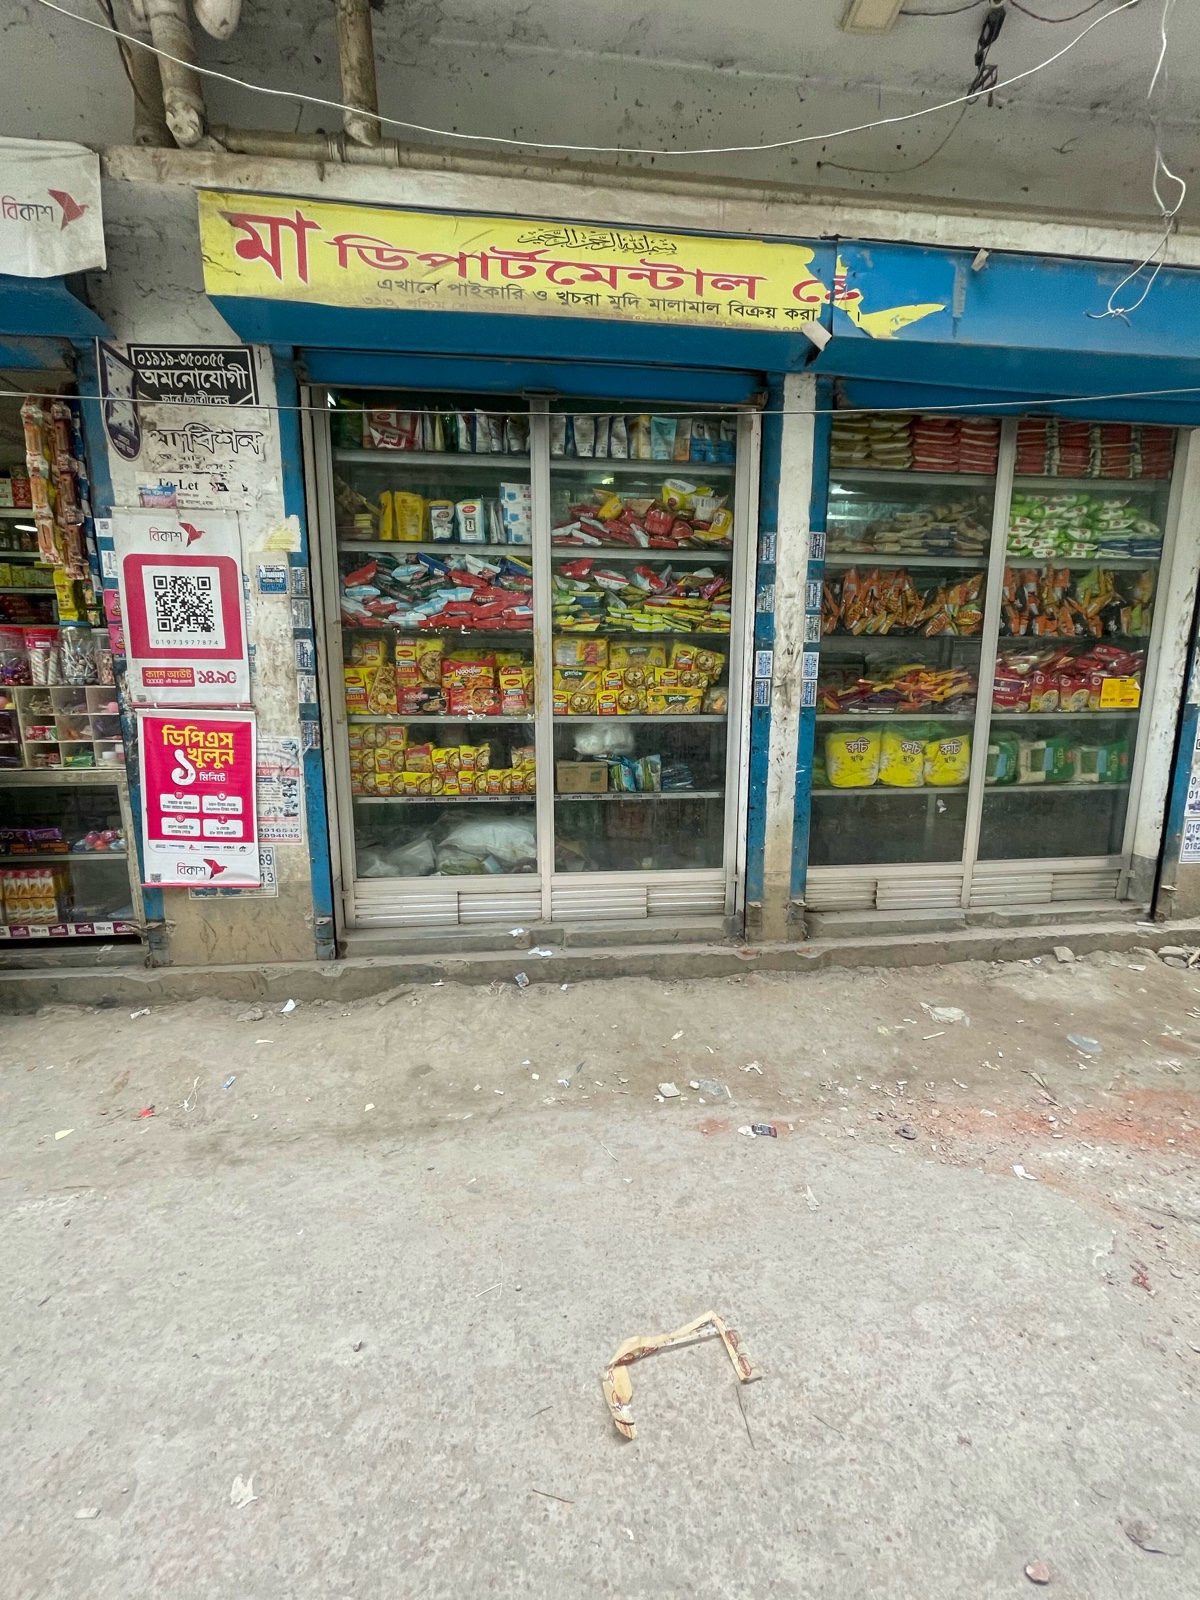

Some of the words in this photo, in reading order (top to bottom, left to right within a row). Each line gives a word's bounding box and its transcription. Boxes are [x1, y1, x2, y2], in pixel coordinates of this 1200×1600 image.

[2, 195, 54, 222] বিকাশ
[217, 209, 322, 285] মা
[324, 233, 768, 301] ডিপার্টমেন্টাল
[377, 277, 443, 294] এখানে
[447, 281, 527, 301] পাইকারি
[532, 290, 548, 301] ও
[556, 290, 602, 307] খুচরা
[609, 292, 642, 310] মুদি
[648, 297, 721, 316] মালামাল
[727, 299, 778, 320] বিক্রয়
[784, 306, 818, 322] করা
[137, 351, 225, 367] ০১৯১৯-৩৫০০৫৫
[137, 363, 249, 390] অমনোযোগী
[158, 478, 199, 491] To-Let
[149, 526, 183, 543] বিকাশ
[145, 670, 166, 679] ক্যাশ
[167, 669, 192, 679] আউট
[161, 724, 234, 749] ডিপিএস
[846, 737, 869, 754] রুচি
[901, 740, 922, 755] রুচি
[939, 739, 962, 755] রুচি
[187, 747, 235, 770] খুলুন
[171, 749, 196, 786] ১
[199, 771, 227, 783] মিনিটে
[176, 862, 206, 875] বিকাশ
